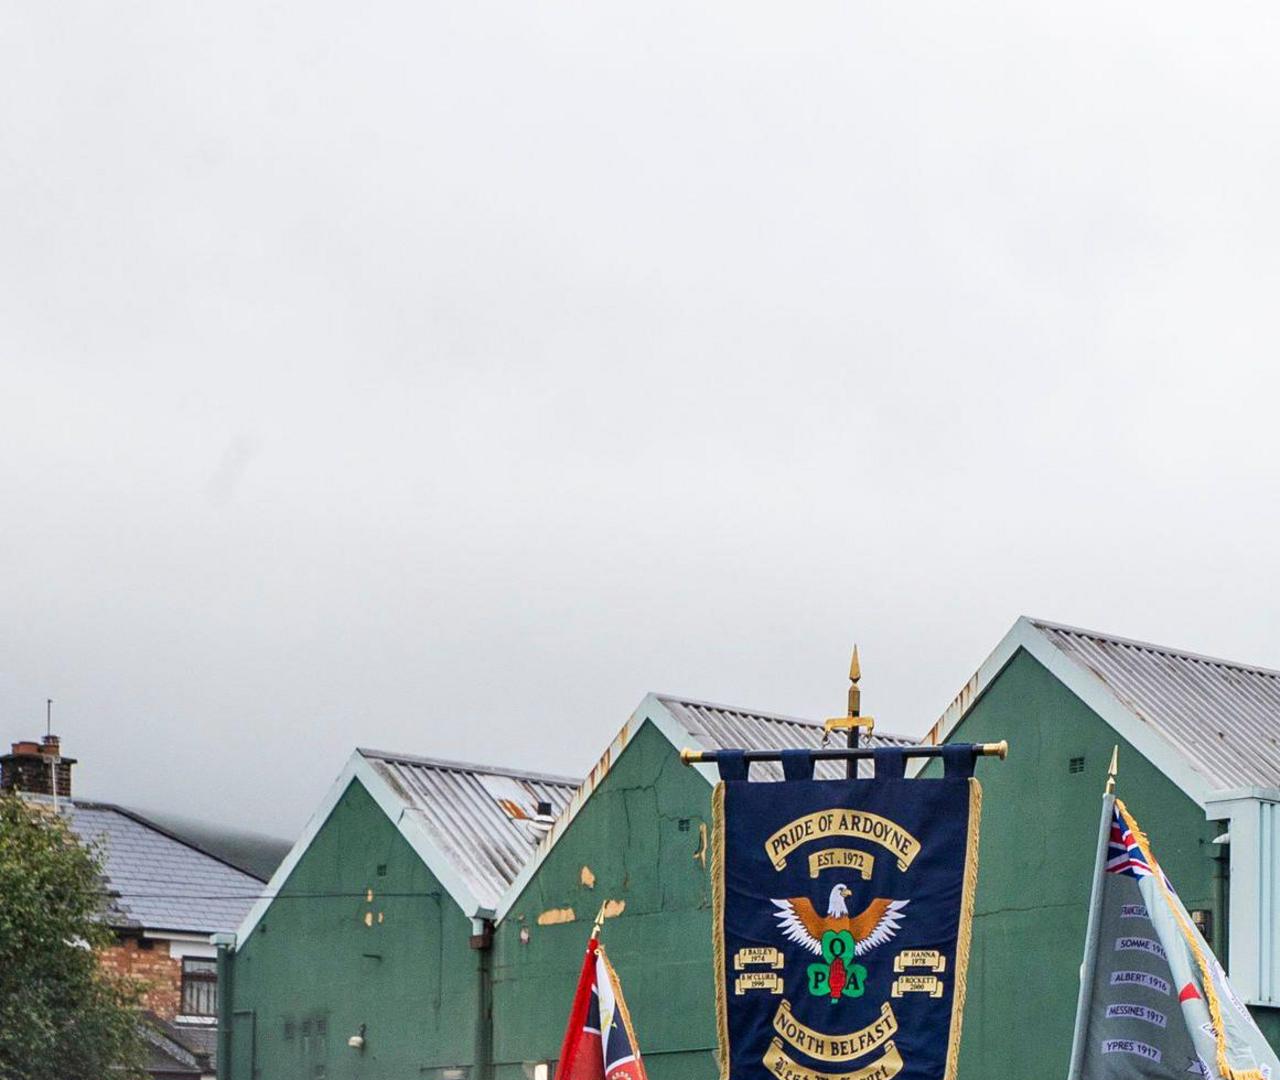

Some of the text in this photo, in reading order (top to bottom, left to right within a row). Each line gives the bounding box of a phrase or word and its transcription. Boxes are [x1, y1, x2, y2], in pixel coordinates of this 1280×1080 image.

[771, 814, 912, 856] PRIDE OF ARDOYNE
[843, 852, 864, 867] 1972
[1120, 939, 1150, 950] SOMME
[813, 971, 860, 990] P A
[1115, 972, 1168, 992] ALBERT 1916
[1108, 1005, 1164, 1024] MESSINES 1917
[776, 1013, 894, 1057] NORTH BELFAST
[1107, 1042, 1158, 1058] YPRES 1917
